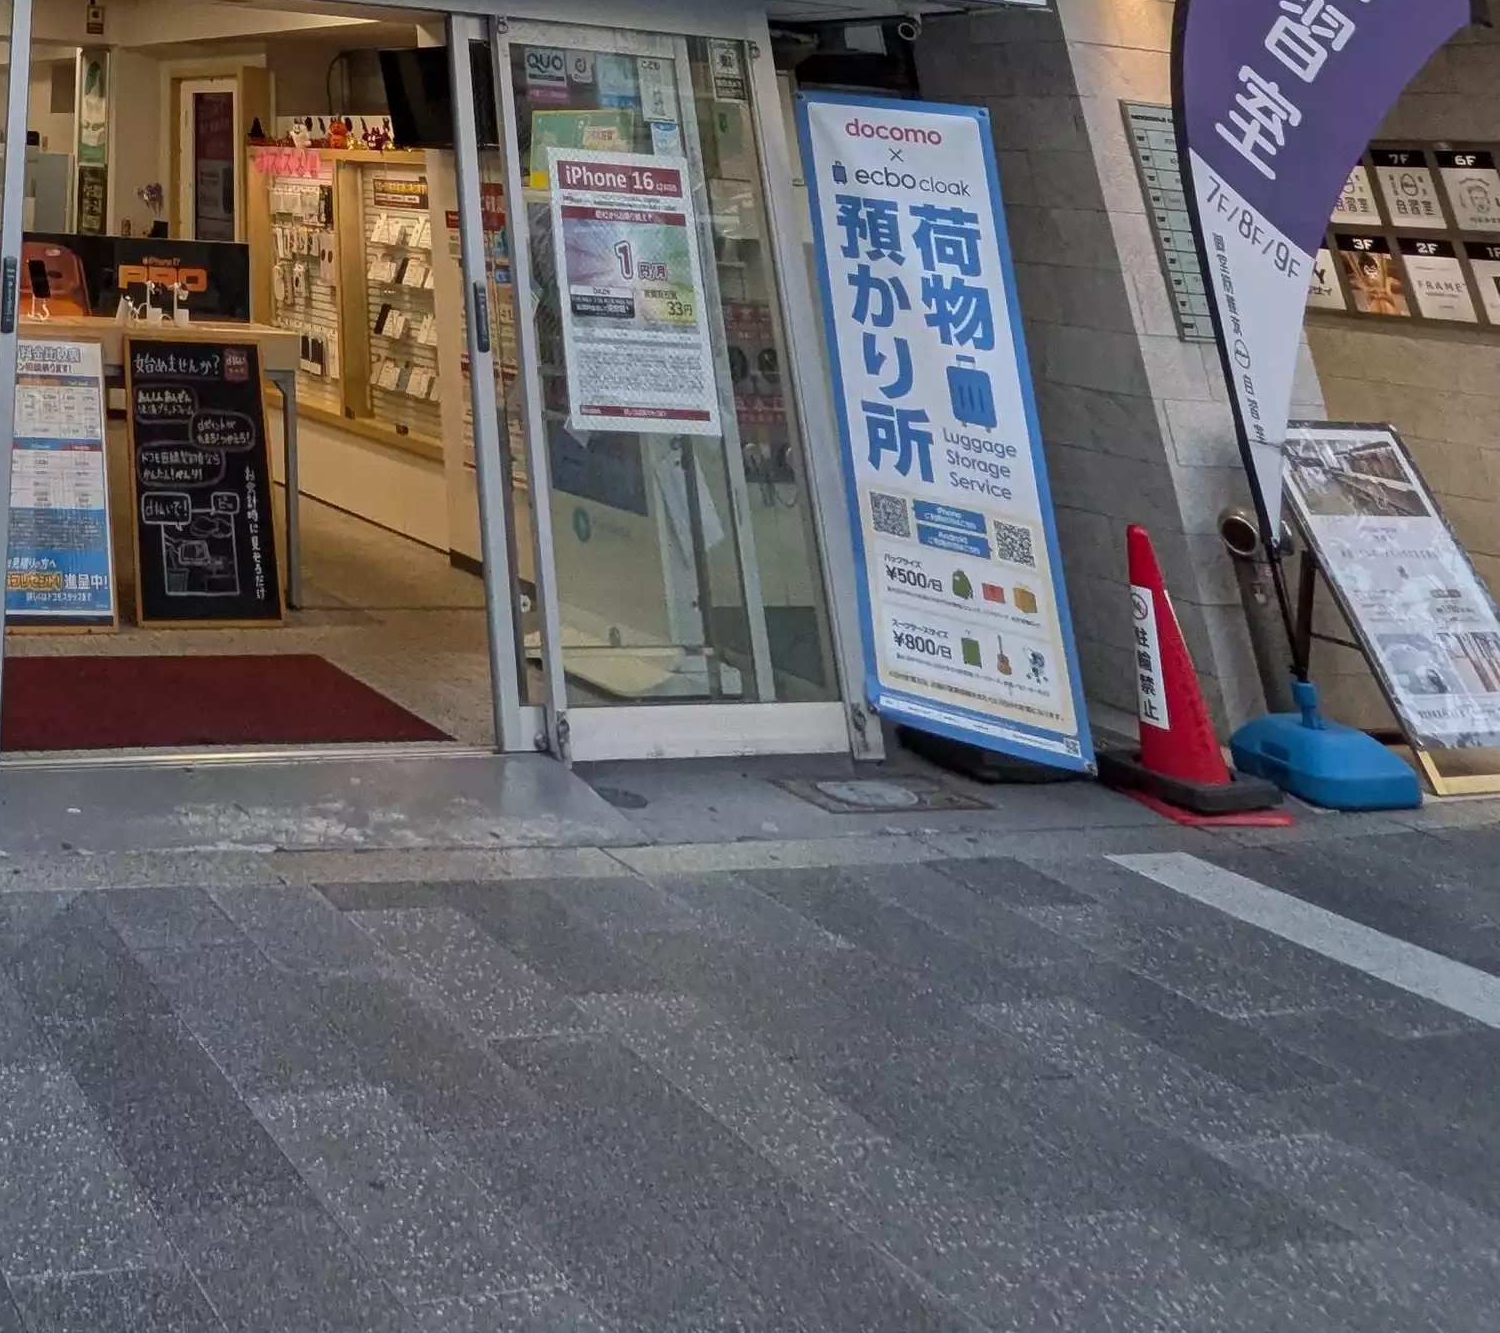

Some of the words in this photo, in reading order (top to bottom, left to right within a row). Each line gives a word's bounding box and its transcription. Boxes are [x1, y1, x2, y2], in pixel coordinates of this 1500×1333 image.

[526, 52, 564, 72] QUO
[844, 118, 943, 146] docomo
[1388, 153, 1410, 166] 7F
[1453, 154, 1477, 167] 6F
[564, 164, 628, 190] iPhone
[631, 170, 655, 191] 16
[855, 164, 917, 191] ecbo
[918, 173, 971, 198] cloak
[1206, 175, 1301, 280] 7F/8F/9F
[1352, 237, 1375, 251] 3F
[1415, 242, 1439, 255] 2F
[910, 204, 996, 352] 荷物
[666, 301, 693, 316] 33円
[836, 194, 936, 485] 預かり所
[942, 429, 1018, 461] Luggage
[946, 449, 1011, 480] Storage
[949, 472, 1013, 501] Service
